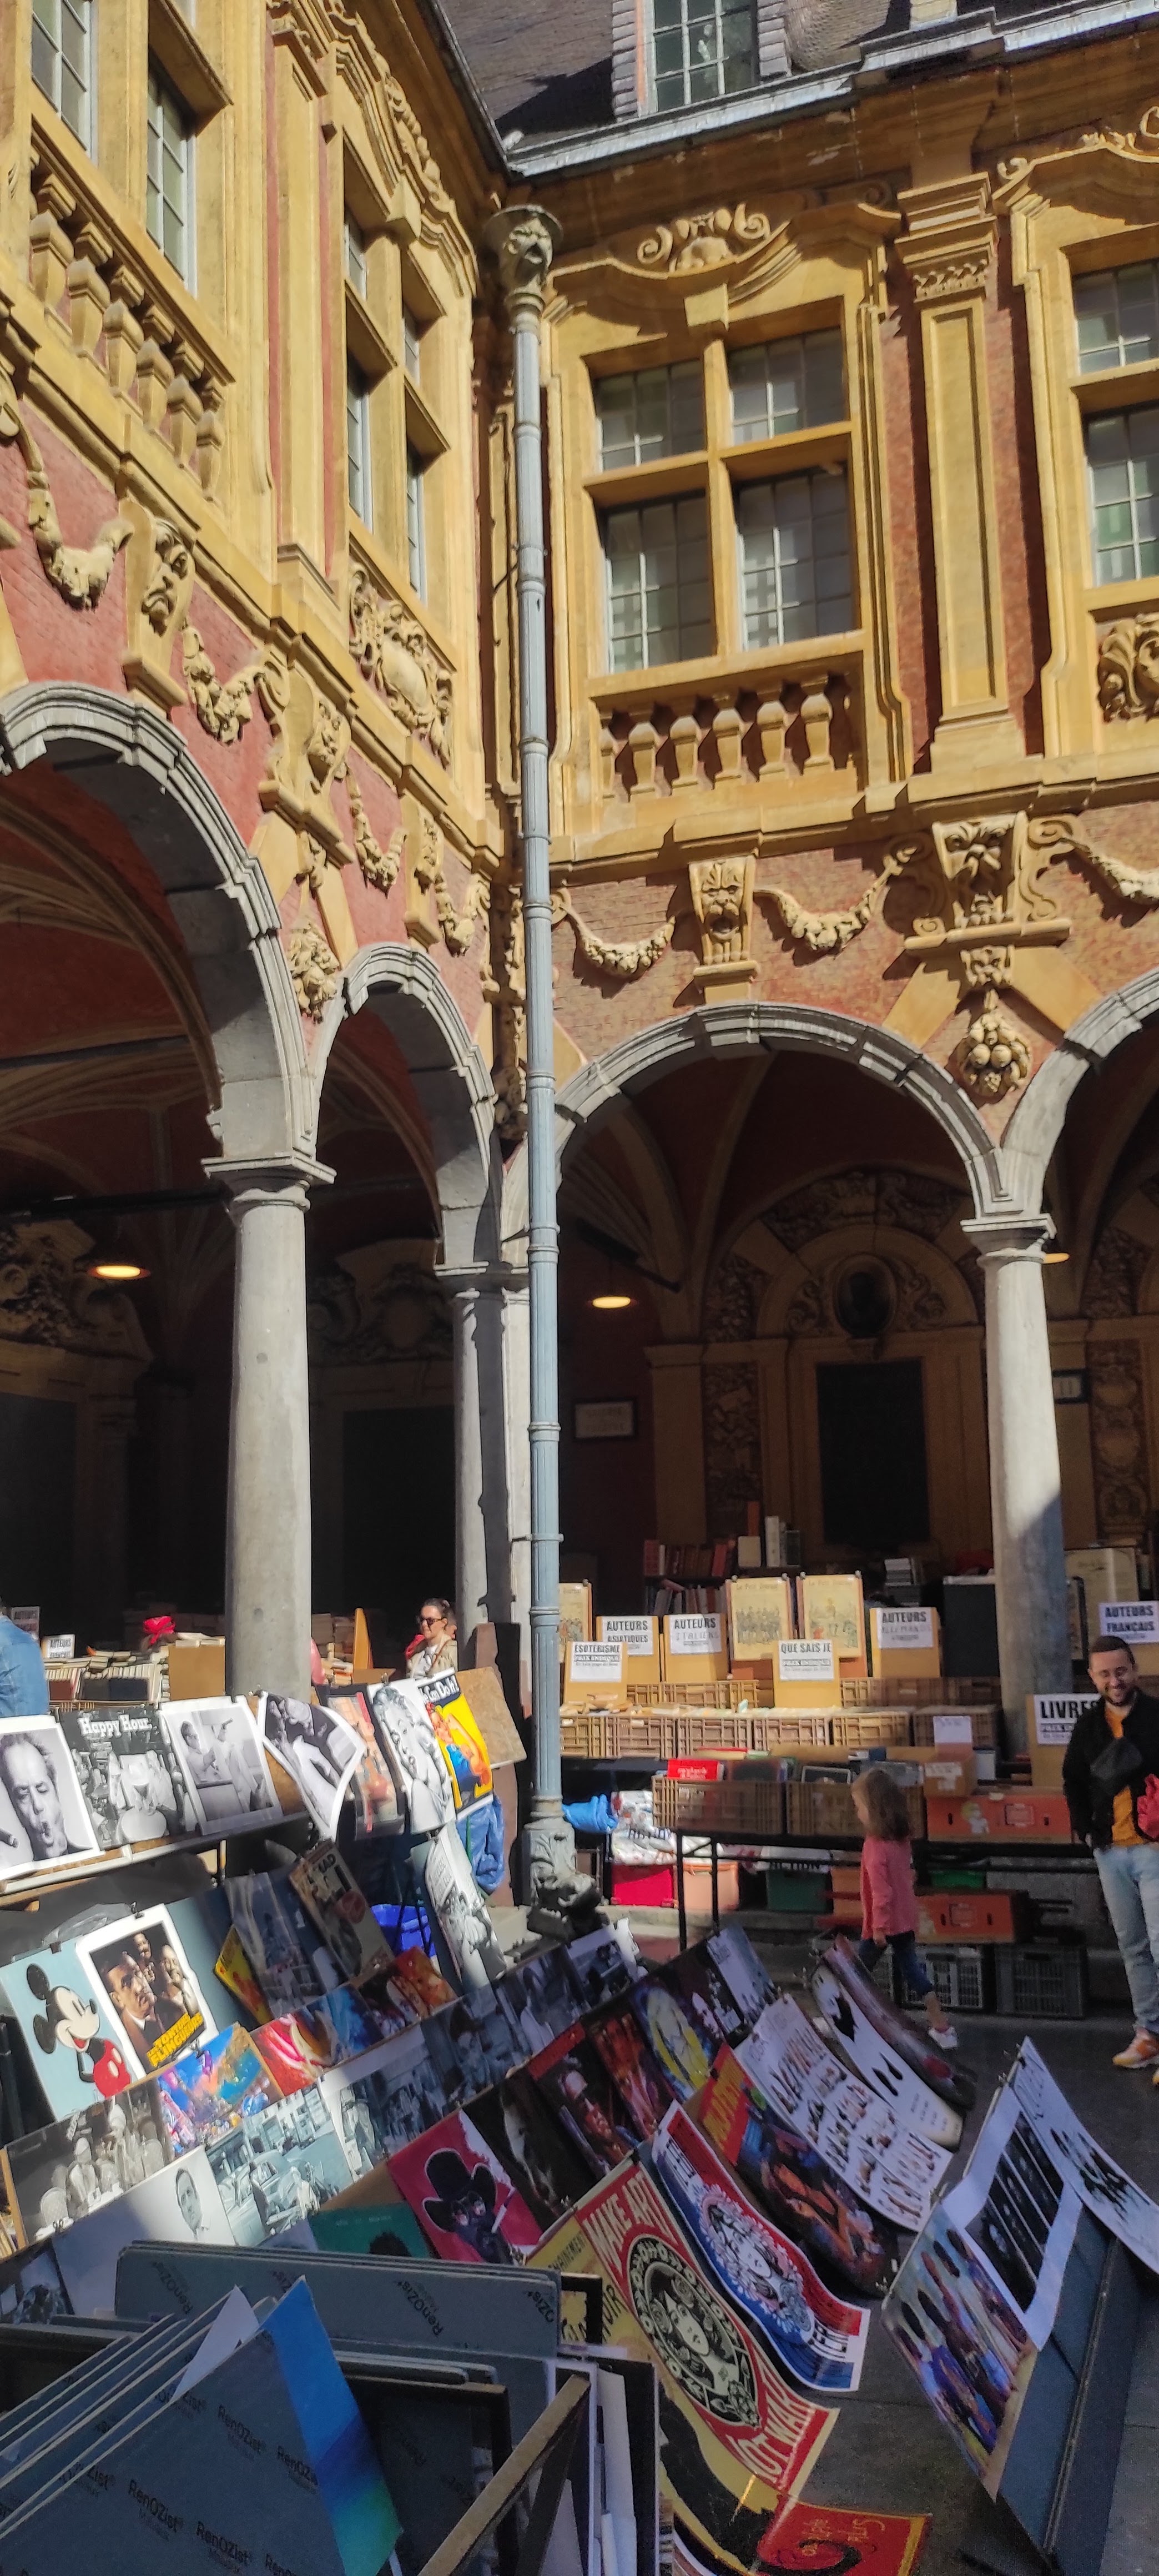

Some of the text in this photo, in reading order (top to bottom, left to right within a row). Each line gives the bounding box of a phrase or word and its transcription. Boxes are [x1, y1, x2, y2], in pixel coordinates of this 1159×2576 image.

[882, 1611, 927, 1623] AUTEURS
[1105, 1605, 1154, 1618] AUTEURS
[606, 1621, 648, 1631] AUTEURS
[674, 1617, 716, 1629] AUTEURS
[781, 1643, 798, 1653] QUE
[800, 1643, 820, 1653] SAIS
[77, 1713, 122, 1738] Happy
[583, 2170, 679, 2278] MAKE ART
[755, 2352, 816, 2448] WAR
